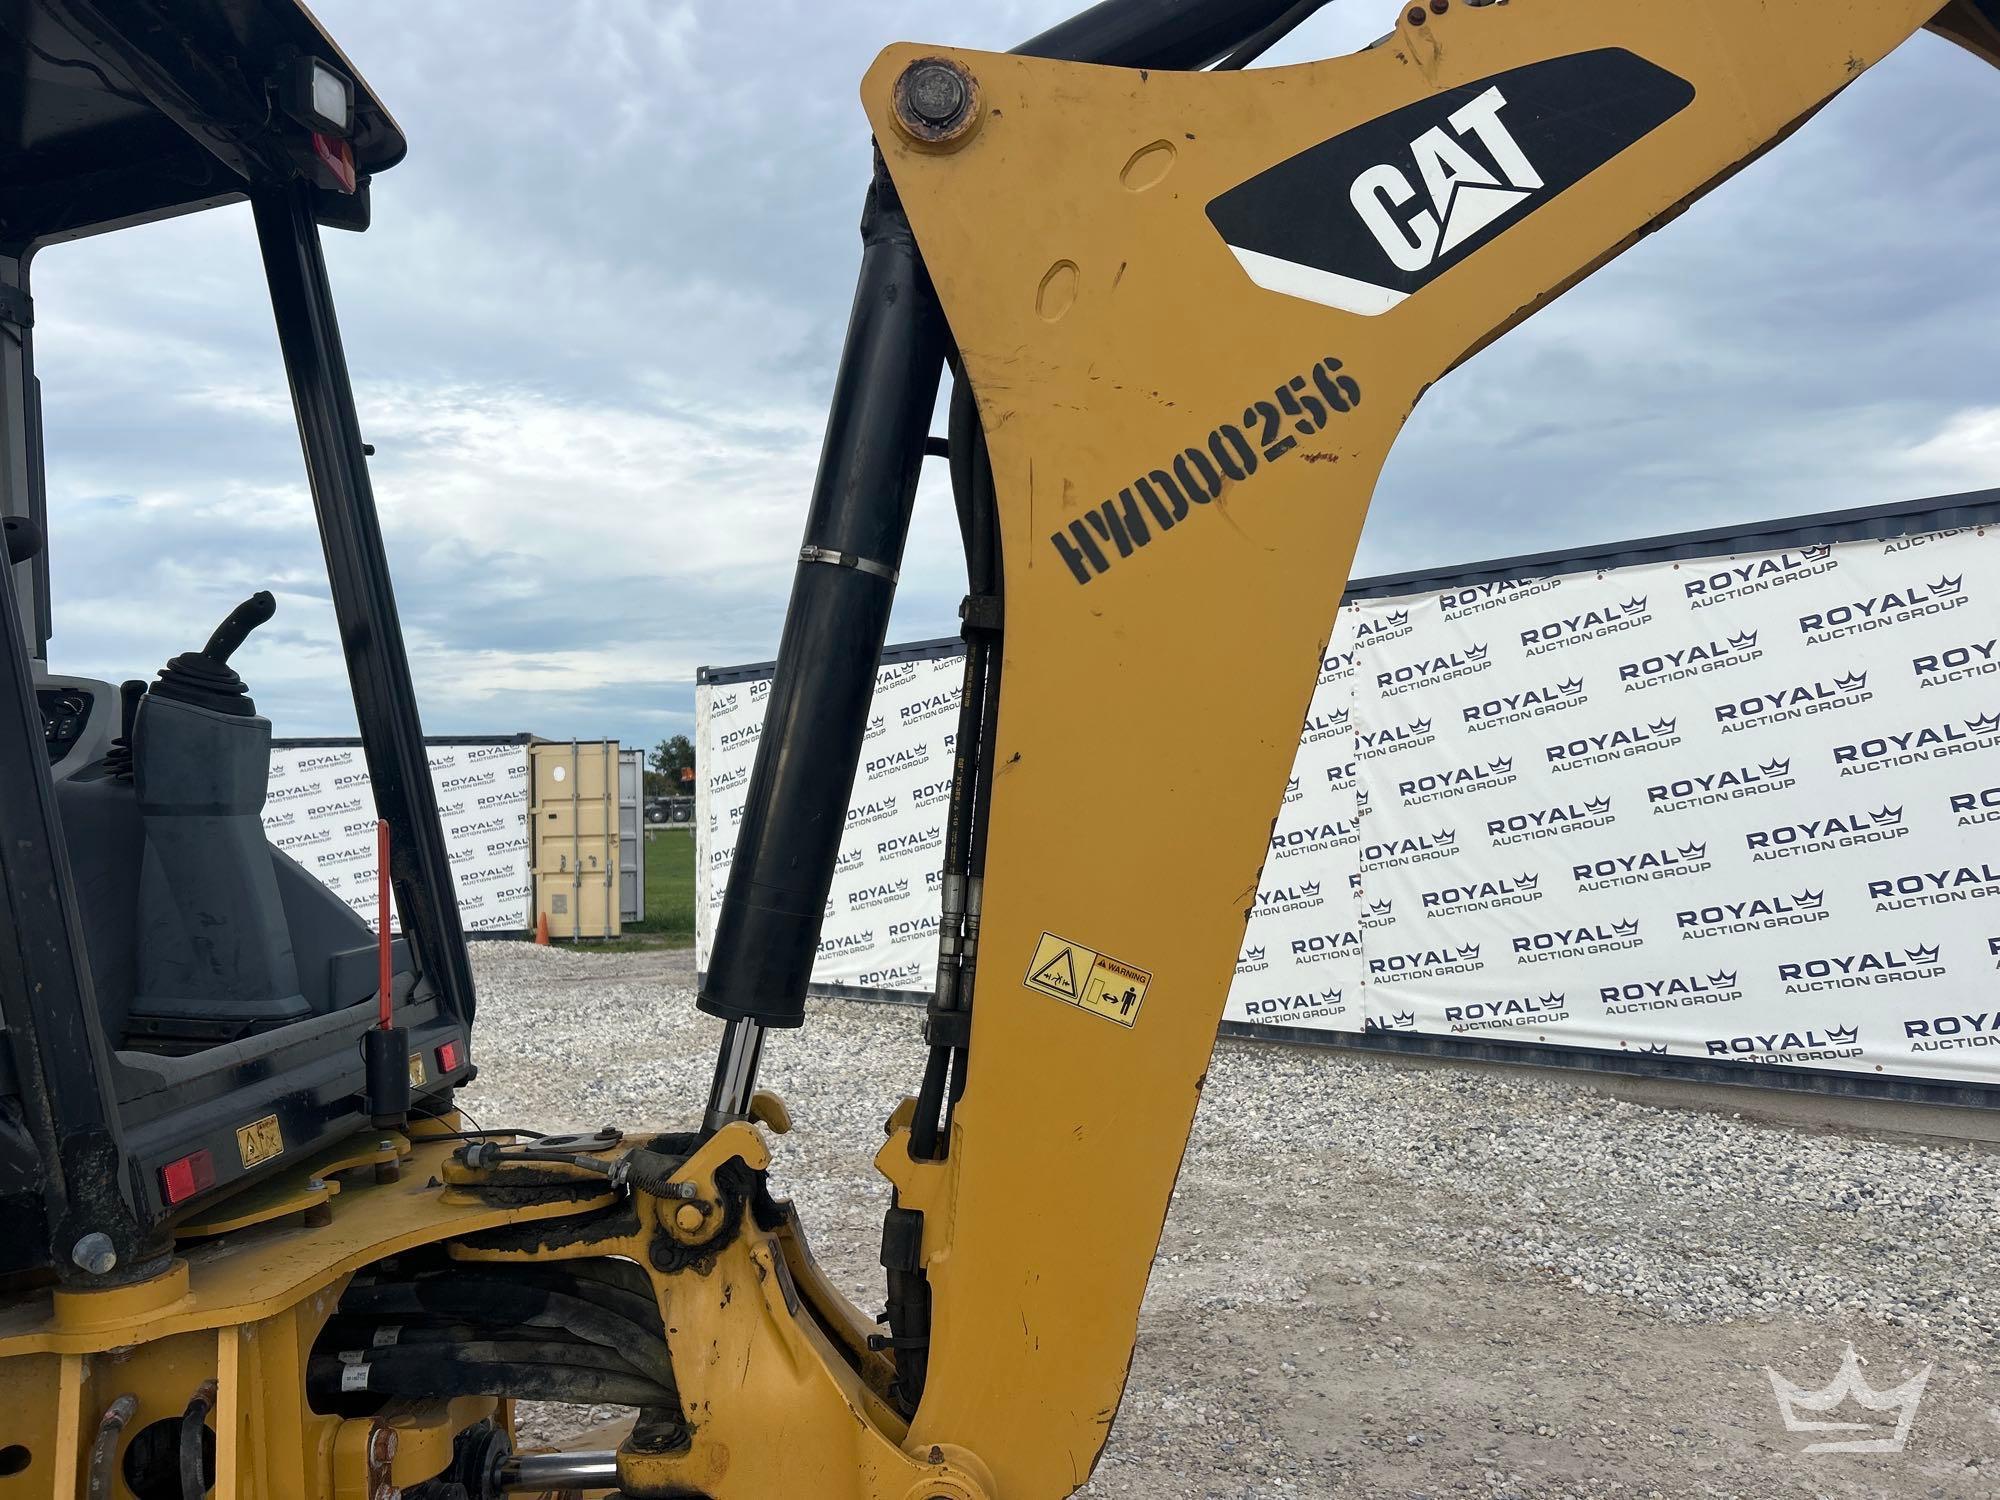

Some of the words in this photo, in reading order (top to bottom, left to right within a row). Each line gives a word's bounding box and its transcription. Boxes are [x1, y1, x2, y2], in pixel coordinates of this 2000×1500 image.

[1349, 85, 1545, 272] CAT
[1051, 356, 1361, 585] HWD00256
[1684, 556, 1802, 598] ROYAL
[1691, 581, 1769, 610] AUCTION
[1772, 561, 1838, 586] GROUP
[1444, 596, 1507, 622] AUCTION
[1509, 579, 1561, 602] GROUP
[1799, 588, 1929, 634] ROYAL
[1520, 608, 1621, 646] ROYAL
[1806, 616, 1893, 646] AUCTION
[1896, 596, 1969, 622] GROUP
[1367, 626, 1413, 647] GROUP
[1526, 631, 1593, 658] AUCTION
[1596, 615, 1652, 637] GROUP
[1377, 657, 1465, 688] ROYAL
[1619, 644, 1729, 681] ROYAL
[1625, 667, 1698, 693] AUCTION
[1701, 650, 1763, 673] GROUP
[890, 674, 917, 689] GROUP
[1381, 675, 1441, 699] AUCTION
[1443, 661, 1492, 681] GROUP
[714, 704, 739, 718] GROUP
[900, 693, 951, 719] ROYAL
[903, 710, 937, 727] AUCTION
[938, 702, 961, 715] GROU
[1463, 687, 1559, 722] ROYAL
[1467, 710, 1532, 733] AUCTION
[1534, 696, 1588, 716] GROUP
[1715, 682, 1836, 722] ROYAL
[1721, 708, 1802, 735] AUCTION
[1805, 692, 1873, 715] GROUP
[1309, 724, 1353, 743] GROUP
[1388, 735, 1435, 753] GROUP
[1546, 728, 1650, 762] ROYAL
[1833, 724, 1967, 764] ROYAL
[298, 755, 340, 768] ROYAL
[468, 745, 510, 759] ROYAL
[866, 750, 915, 773] ROYAL
[1552, 750, 1621, 774] AUCTION
[1623, 736, 1681, 757] GROUP
[1840, 751, 1929, 777] AUCTION
[868, 765, 901, 781] AUCTION
[902, 756, 929, 770] GROUP
[267, 786, 309, 799] ROYAL
[441, 775, 483, 788] ROYAL
[1399, 767, 1489, 796] ROYAL
[1404, 787, 1464, 807] AUCTION
[1466, 775, 1517, 793] GROUP
[1647, 767, 1761, 803] ROYAL
[307, 802, 349, 815] ROYAL
[477, 791, 520, 805] ROYAL
[915, 794, 950, 808] AUCTION
[1653, 792, 1729, 815] AUCTION
[1732, 778, 1796, 799] GROUP
[451, 821, 493, 835] ROYAL
[872, 809, 898, 822] GROUP
[1487, 806, 1586, 836] ROYAL
[277, 833, 318, 846] ROYAL
[877, 832, 927, 854] ROYAL
[1271, 821, 1351, 849] ROYAL
[1492, 827, 1558, 847] AUCTION
[1561, 815, 1615, 833] GROUP
[1746, 816, 1871, 850] ROYAL
[317, 849, 360, 863] ROYAL
[880, 848, 913, 862] AUCTION
[914, 839, 942, 852] GROUP
[1275, 842, 1328, 860] AUCTION
[1360, 836, 1433, 862] OYAL
[1753, 840, 1836, 862] AUCTION
[1839, 827, 1909, 847] GROUP
[839, 861, 864, 874] GROUP
[1360, 856, 1409, 873] UCTION
[1411, 847, 1460, 863] GROUP
[1573, 851, 1679, 881] ROYAL
[460, 868, 502, 882] ROYAL
[1578, 873, 1649, 893] AUCTION
[1652, 862, 1711, 880] GROUP
[1868, 864, 2000, 899] ROYAL
[849, 884, 896, 904] ROYAL
[850, 899, 883, 912] AUCTION
[883, 891, 911, 904] GROUP
[1282, 898, 1324, 912] GROUP
[1422, 883, 1514, 908] ROYAL
[1427, 901, 1489, 918] AUCTION
[1491, 892, 1543, 908] GROUP
[1875, 890, 1966, 912] AUCTION
[470, 915, 512, 928] ROYAL
[1676, 898, 1793, 928] ROYAL
[1682, 921, 1760, 940] AUCTION
[1763, 911, 1830, 928] GROUP
[889, 916, 939, 936] ROYAL
[890, 931, 926, 944] AUCTION
[816, 935, 861, 953] ROYAL
[818, 949, 849, 960] AUCTION
[849, 943, 875, 954] GROUP
[1512, 927, 1613, 953] ROYAL
[1517, 947, 1585, 965] AUCTION
[1587, 938, 1643, 954] GROUP
[1295, 949, 1350, 964] AUCTION
[1369, 951, 1457, 973] ROYAL
[1778, 952, 1907, 981] ROYAL
[859, 967, 907, 985] ROYAL
[895, 976, 922, 987] GROUP
[1108, 962, 1146, 984] WARNING
[1374, 969, 1433, 984] AUCTION
[1435, 962, 1484, 976] GROUP
[1785, 976, 1871, 994] AUCTION
[1874, 967, 1946, 984] GROUP
[1600, 978, 1709, 1003] ROYAL
[1606, 999, 1678, 1015] AUCTION
[1681, 991, 1742, 1006] GROUP
[1245, 997, 1322, 1015] ROYAL
[1302, 1006, 1346, 1018] GROUP
[1445, 1000, 1541, 1022] ROYAL
[1451, 1018, 1514, 1033] AUCTION
[1516, 1012, 1569, 1026] GROUP
[1705, 1032, 1826, 1056] ROYAL
[1795, 1048, 1863, 1061] GROUP
